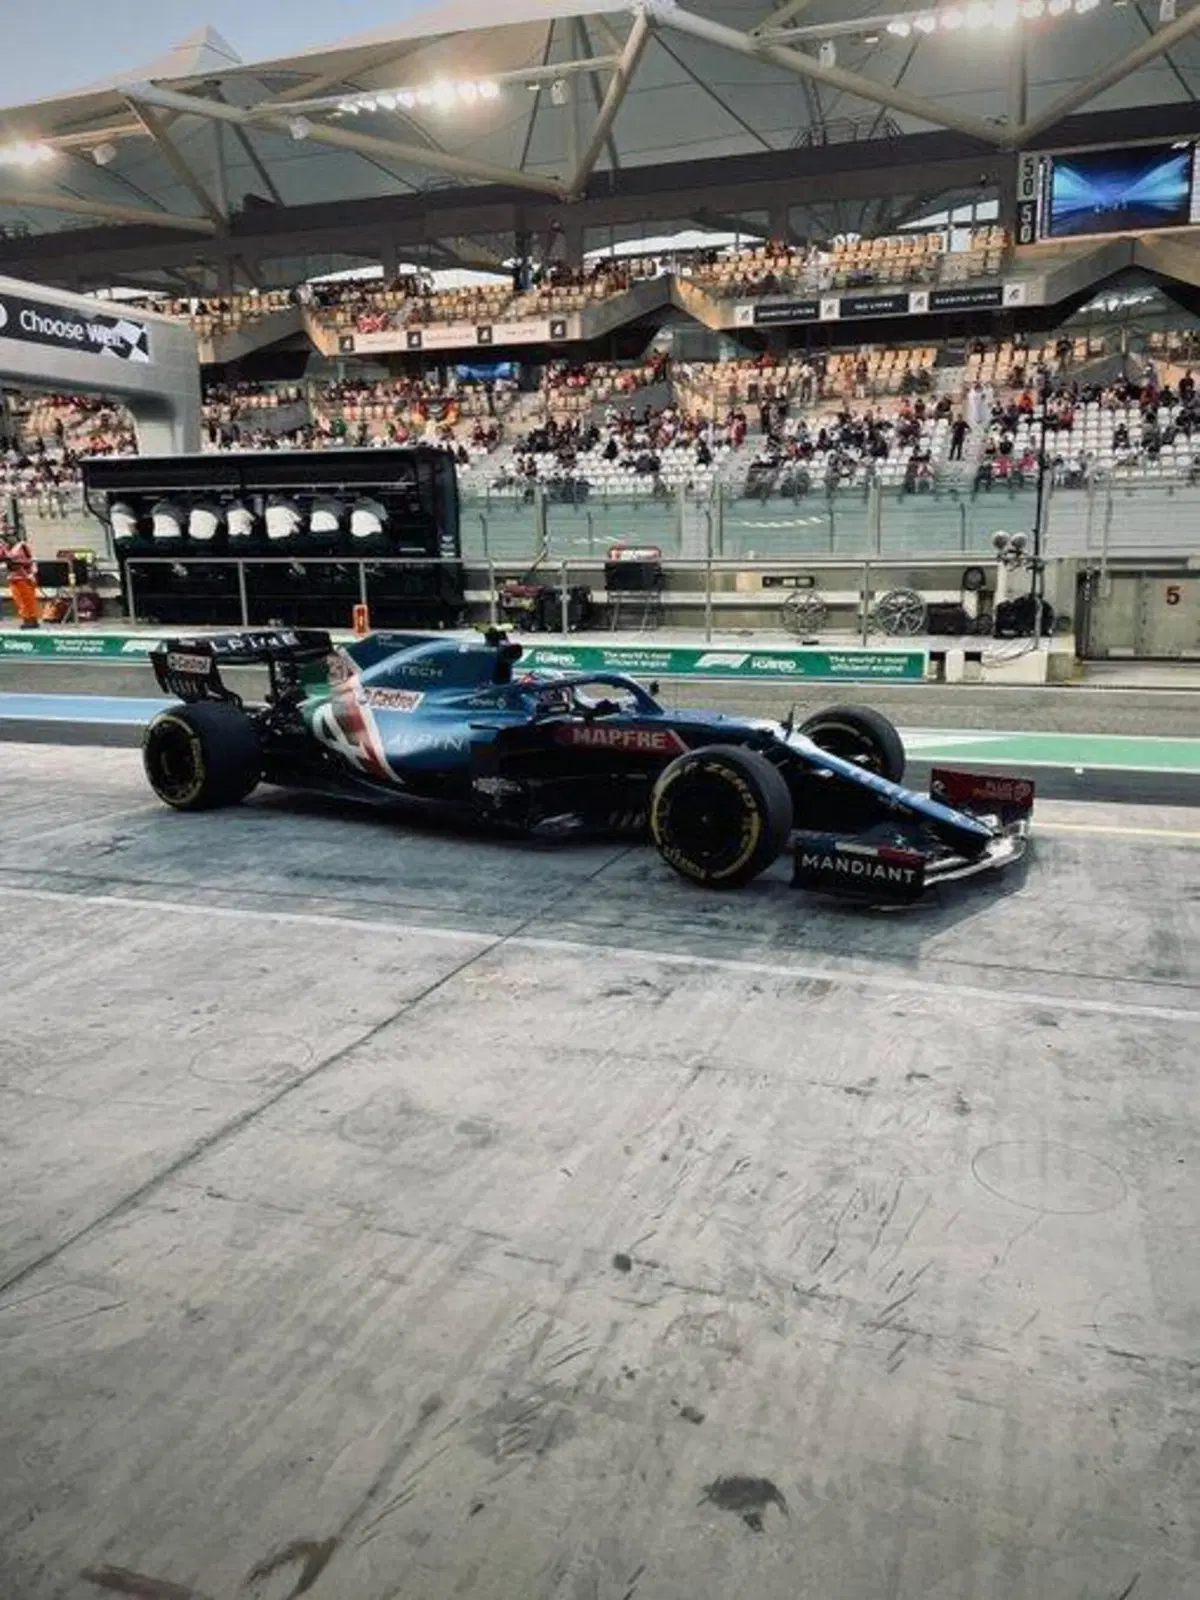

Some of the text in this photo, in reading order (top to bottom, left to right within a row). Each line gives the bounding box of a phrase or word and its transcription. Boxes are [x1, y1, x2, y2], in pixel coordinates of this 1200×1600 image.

[20, 309, 85, 340] Choose
[1166, 585, 1180, 606] 5
[572, 728, 667, 749] MAPFRE
[801, 853, 917, 884] MANDIANT
